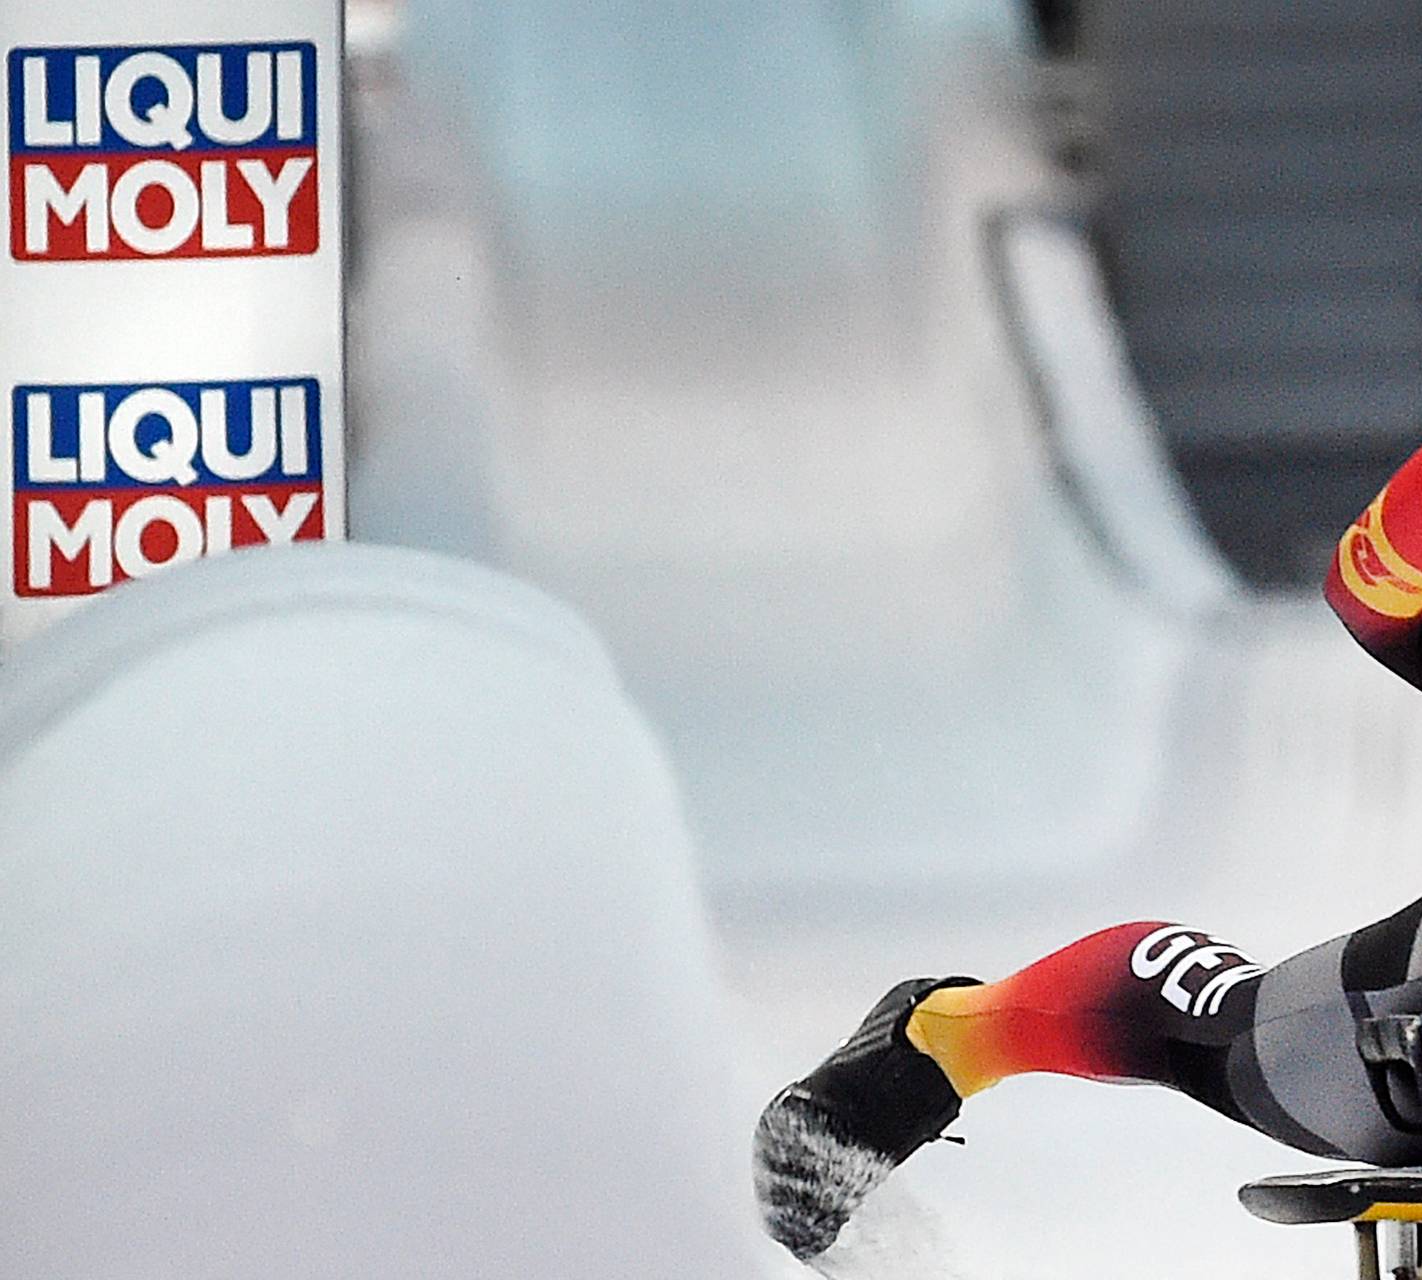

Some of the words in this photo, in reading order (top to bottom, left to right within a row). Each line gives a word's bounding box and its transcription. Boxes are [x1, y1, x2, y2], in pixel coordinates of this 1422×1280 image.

[23, 51, 303, 151] LIQUI
[24, 157, 313, 255] MOLY
[27, 386, 307, 487] LIQUI
